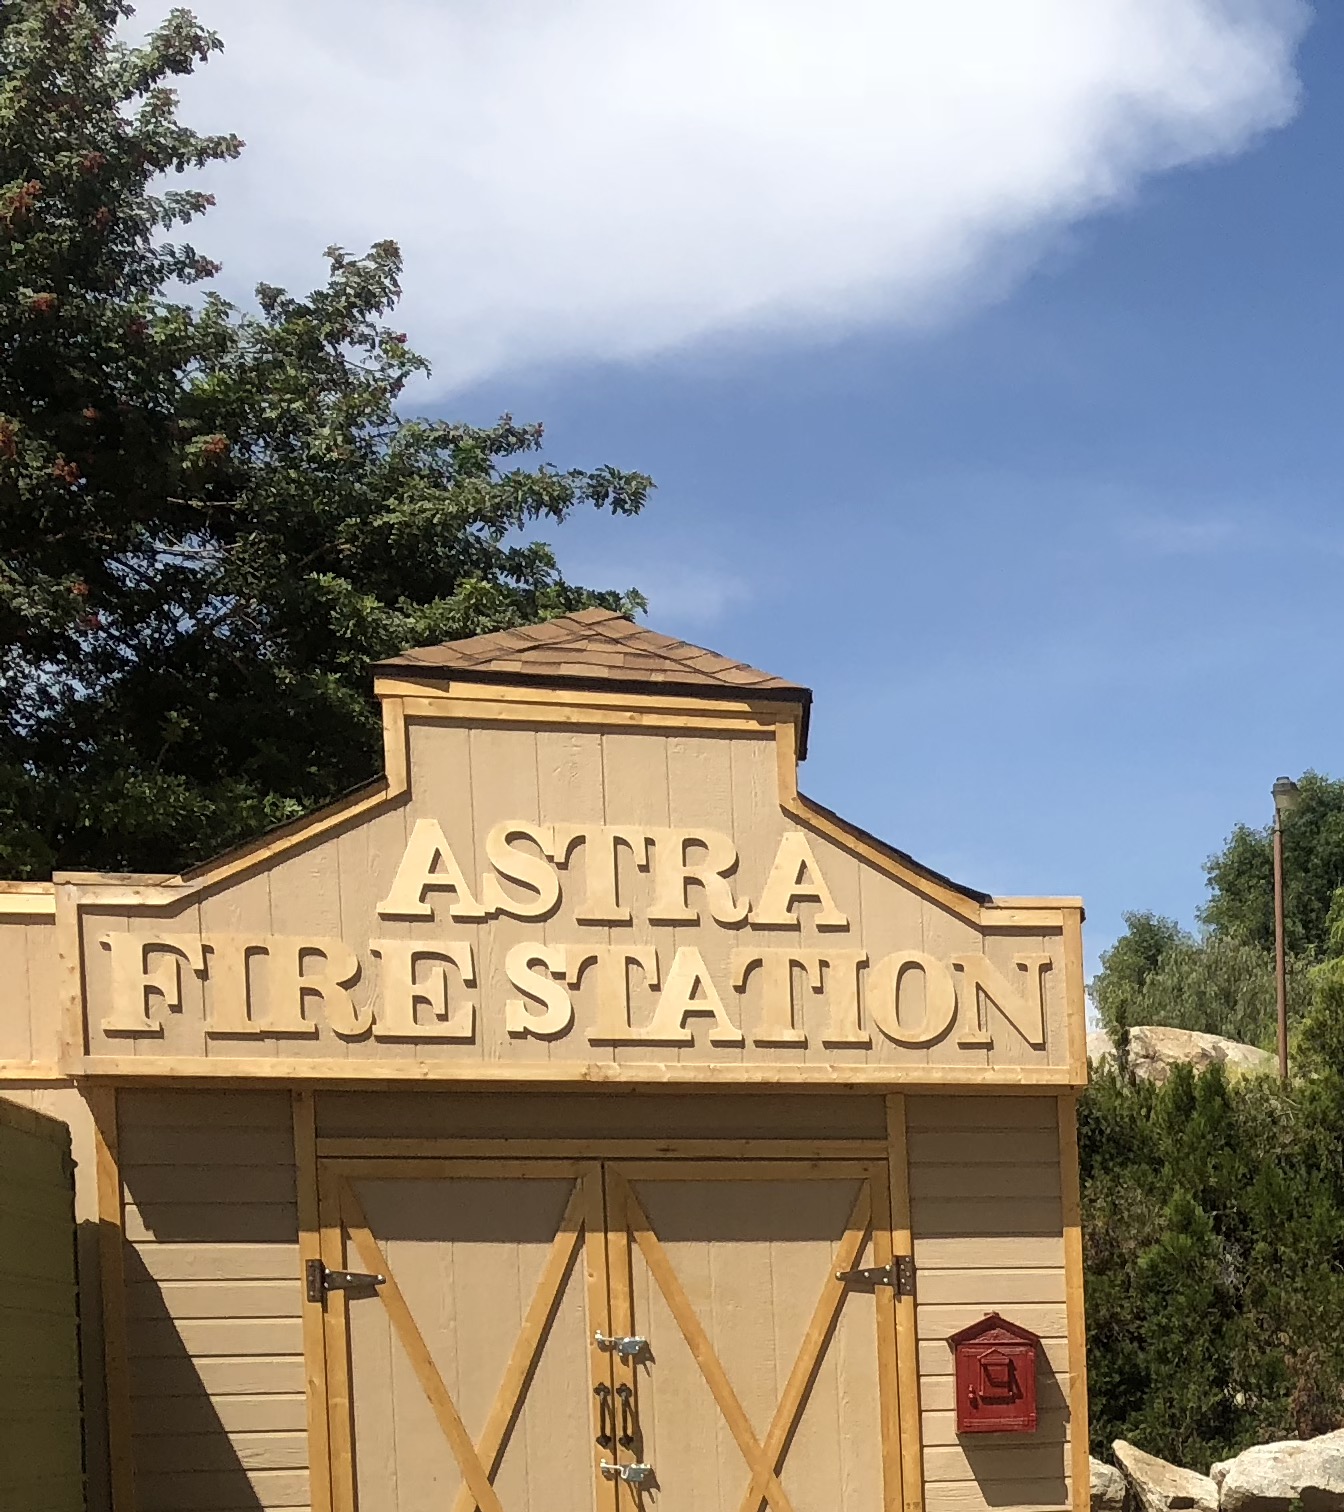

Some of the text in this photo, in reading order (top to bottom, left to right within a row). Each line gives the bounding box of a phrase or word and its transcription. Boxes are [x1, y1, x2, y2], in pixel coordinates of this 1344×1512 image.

[377, 817, 850, 931] ASTRA
[100, 931, 1053, 1050] FIRE STATION
